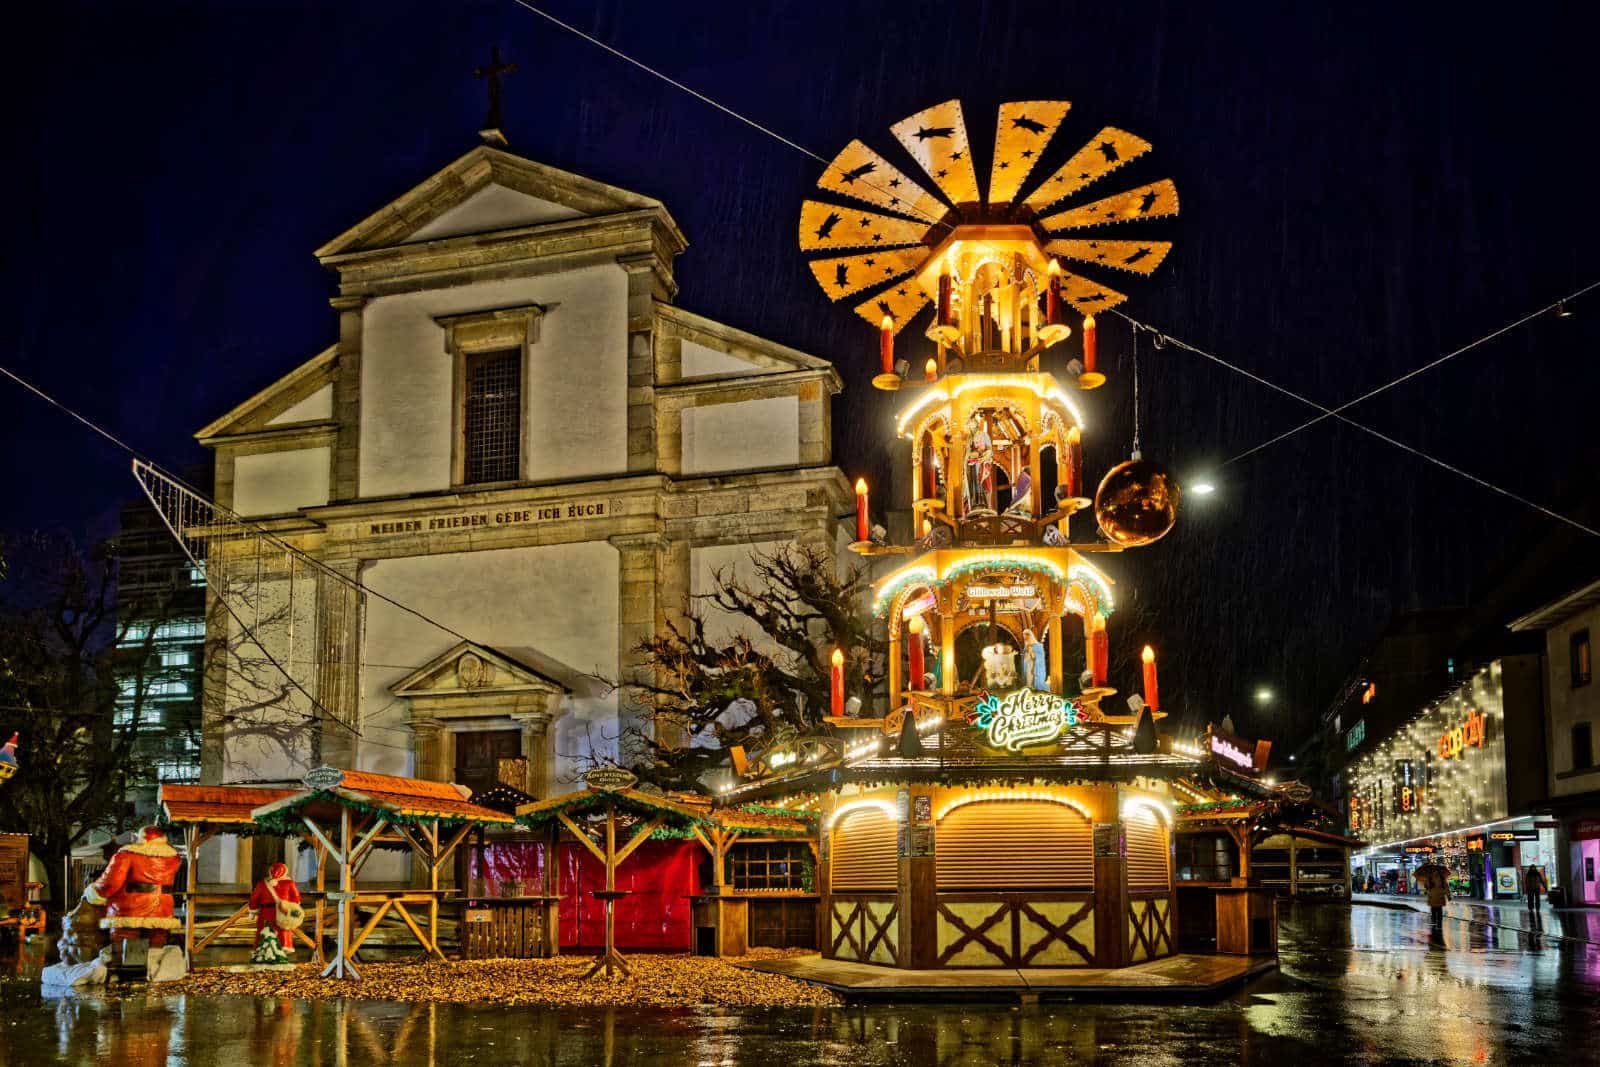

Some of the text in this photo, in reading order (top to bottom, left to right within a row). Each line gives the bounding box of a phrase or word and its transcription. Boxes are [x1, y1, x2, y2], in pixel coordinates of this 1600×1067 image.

[428, 514, 488, 530] FRIEDEN
[495, 510, 530, 524] GEBE
[538, 507, 561, 520] ICH
[568, 503, 605, 518] EUCH
[1000, 687, 1064, 717] Merry
[990, 709, 1063, 746] Christmas
[1437, 727, 1463, 761] coop
